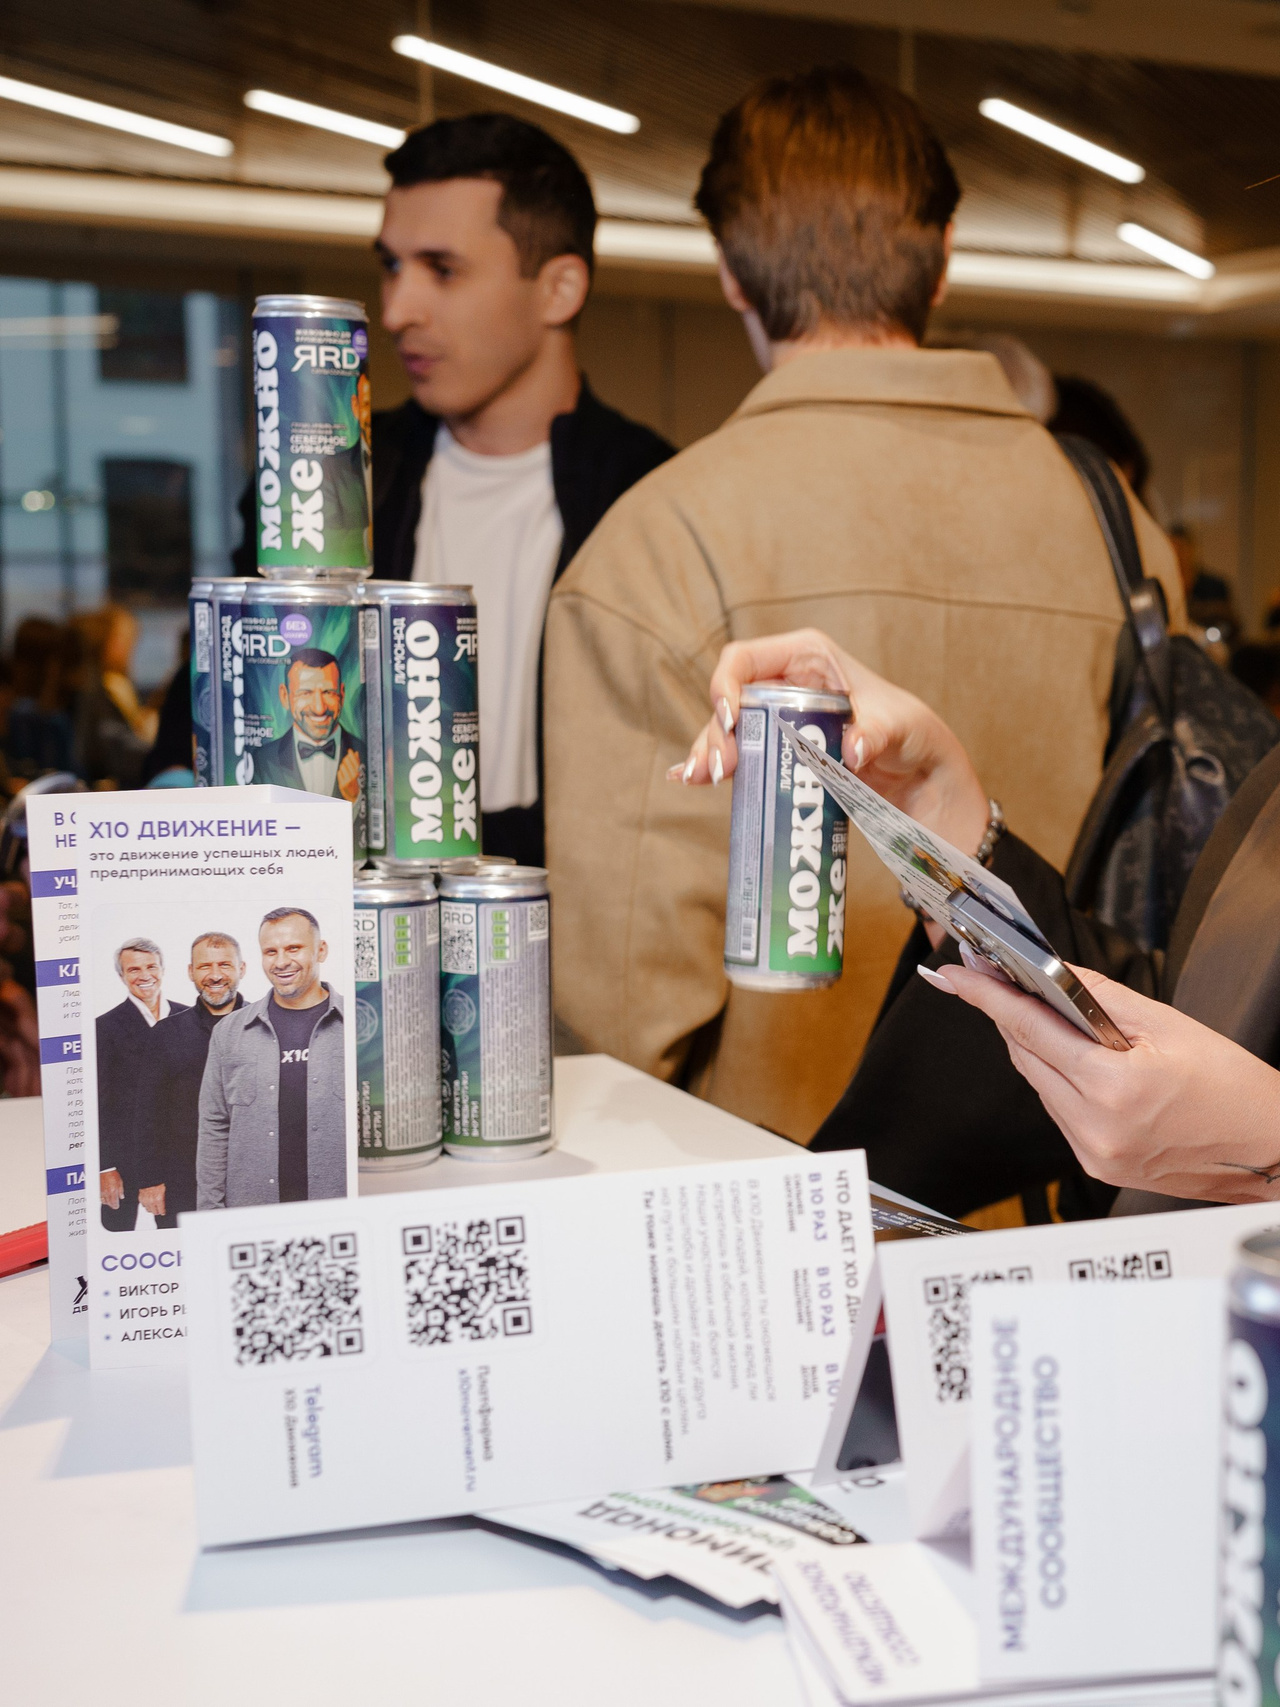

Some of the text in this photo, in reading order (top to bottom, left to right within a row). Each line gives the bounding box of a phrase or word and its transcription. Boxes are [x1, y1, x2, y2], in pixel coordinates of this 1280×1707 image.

[138, 819, 277, 840] ДВИЖЕНИЕ
[90, 846, 338, 862] это движение успешных людей,
[54, 875, 78, 889] УЧ
[90, 863, 283, 881] предпринимающих себя
[836, 1170, 850, 1204] ЧТО
[808, 1173, 828, 1241] В 10 РАЗ
[838, 1210, 856, 1253] ДАЕТ
[101, 1250, 183, 1272] СООС
[119, 1282, 179, 1297] ВИКТОР
[649, 1254, 662, 1316] можешь
[817, 1267, 836, 1336] В 10 РАЗ
[120, 1306, 168, 1320] ИГОРЬ
[121, 1327, 188, 1342] АЛЕКСА
[652, 1320, 667, 1374] делать
[302, 1384, 323, 1479] Telegram
[993, 1319, 1025, 1651] МЕЖДУНАРОДНОЕ
[1034, 1356, 1066, 1609] СООБЩЕСТВО
